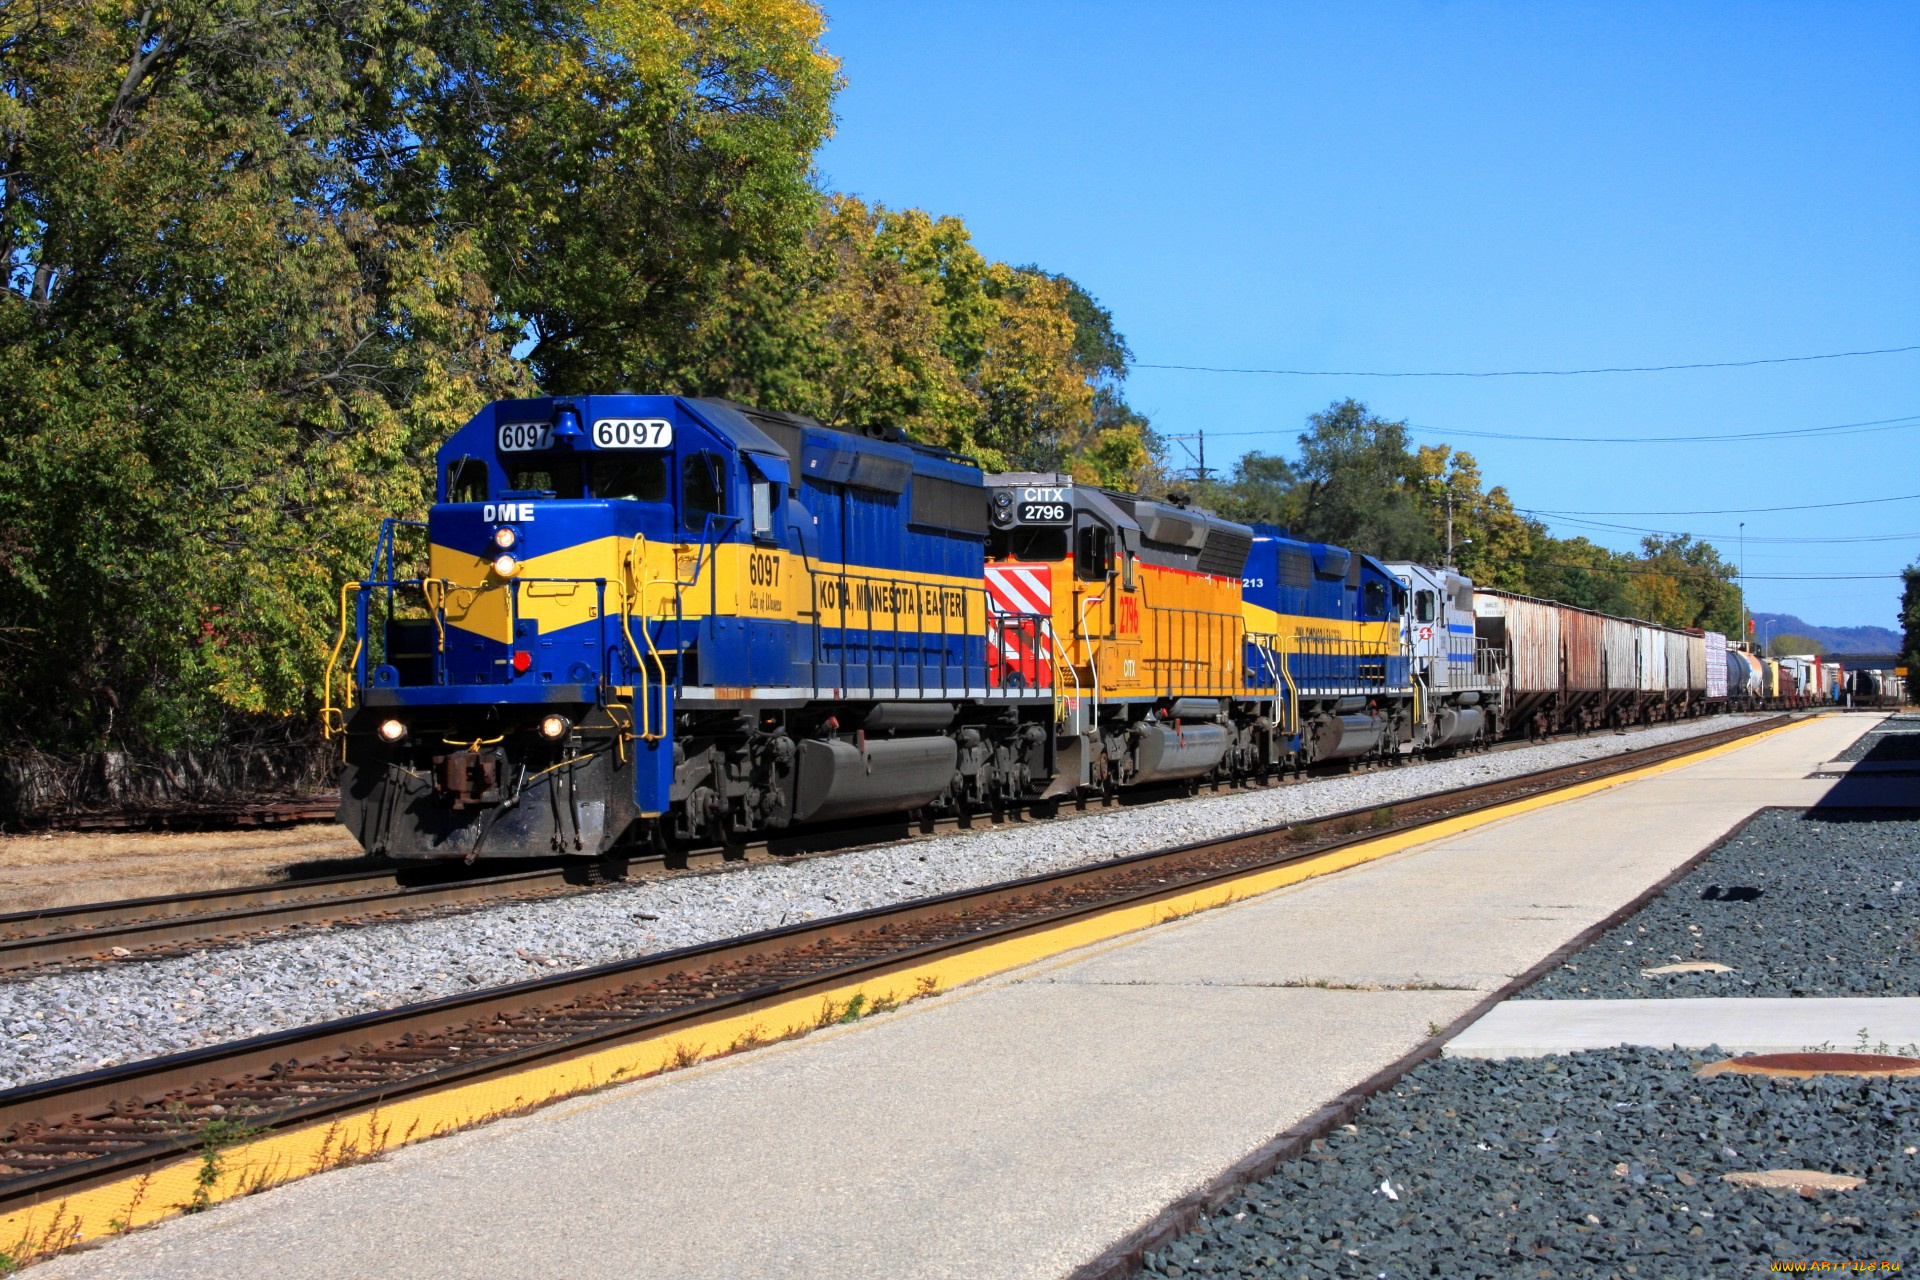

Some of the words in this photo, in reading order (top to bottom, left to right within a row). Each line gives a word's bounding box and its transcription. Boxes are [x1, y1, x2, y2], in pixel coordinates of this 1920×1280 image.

[502, 424, 551, 449] 6097
[598, 422, 665, 445] 6097
[1024, 488, 1064, 502] CITX
[483, 503, 535, 522] DME
[1025, 505, 1065, 520] 2796
[749, 553, 780, 587] 6097
[1242, 578, 1264, 588] 213
[1119, 596, 1139, 634] 2796
[1123, 659, 1136, 677] CITX
